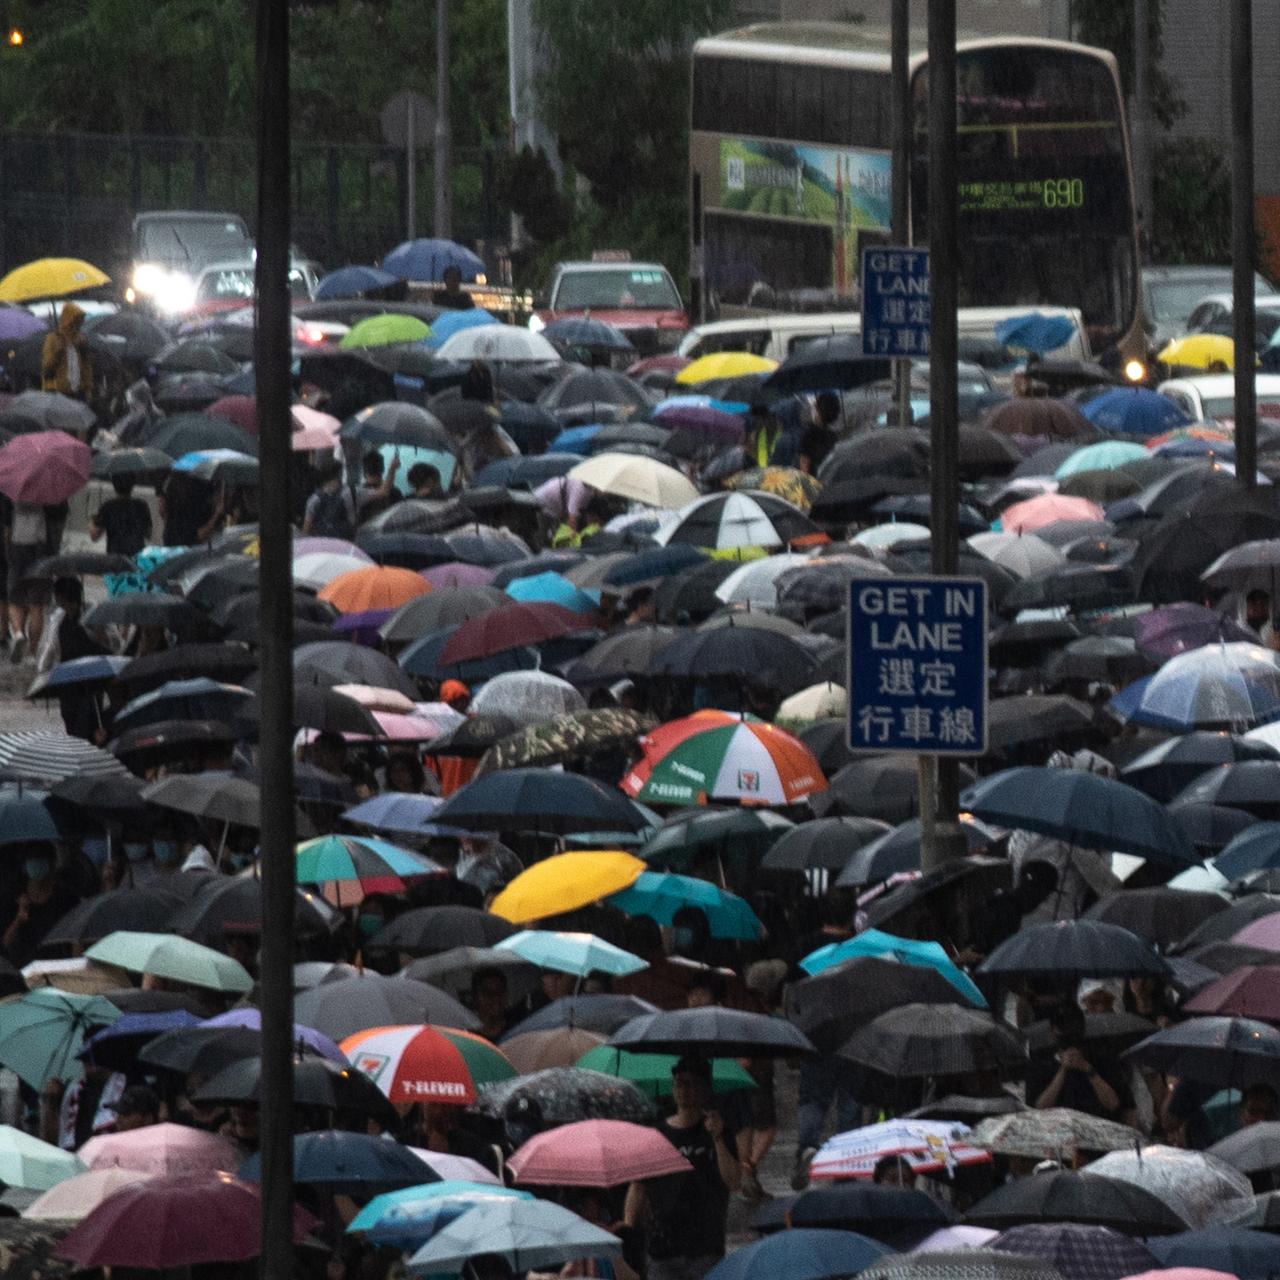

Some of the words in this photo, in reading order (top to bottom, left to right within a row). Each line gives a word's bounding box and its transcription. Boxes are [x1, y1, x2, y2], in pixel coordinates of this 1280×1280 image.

[1043, 179, 1083, 208] 690
[871, 254, 918, 273] GET
[859, 587, 932, 616] GET
[945, 587, 976, 617] IN
[870, 622, 964, 651] LANE
[879, 658, 956, 697] 選定
[858, 704, 978, 744] 行車線
